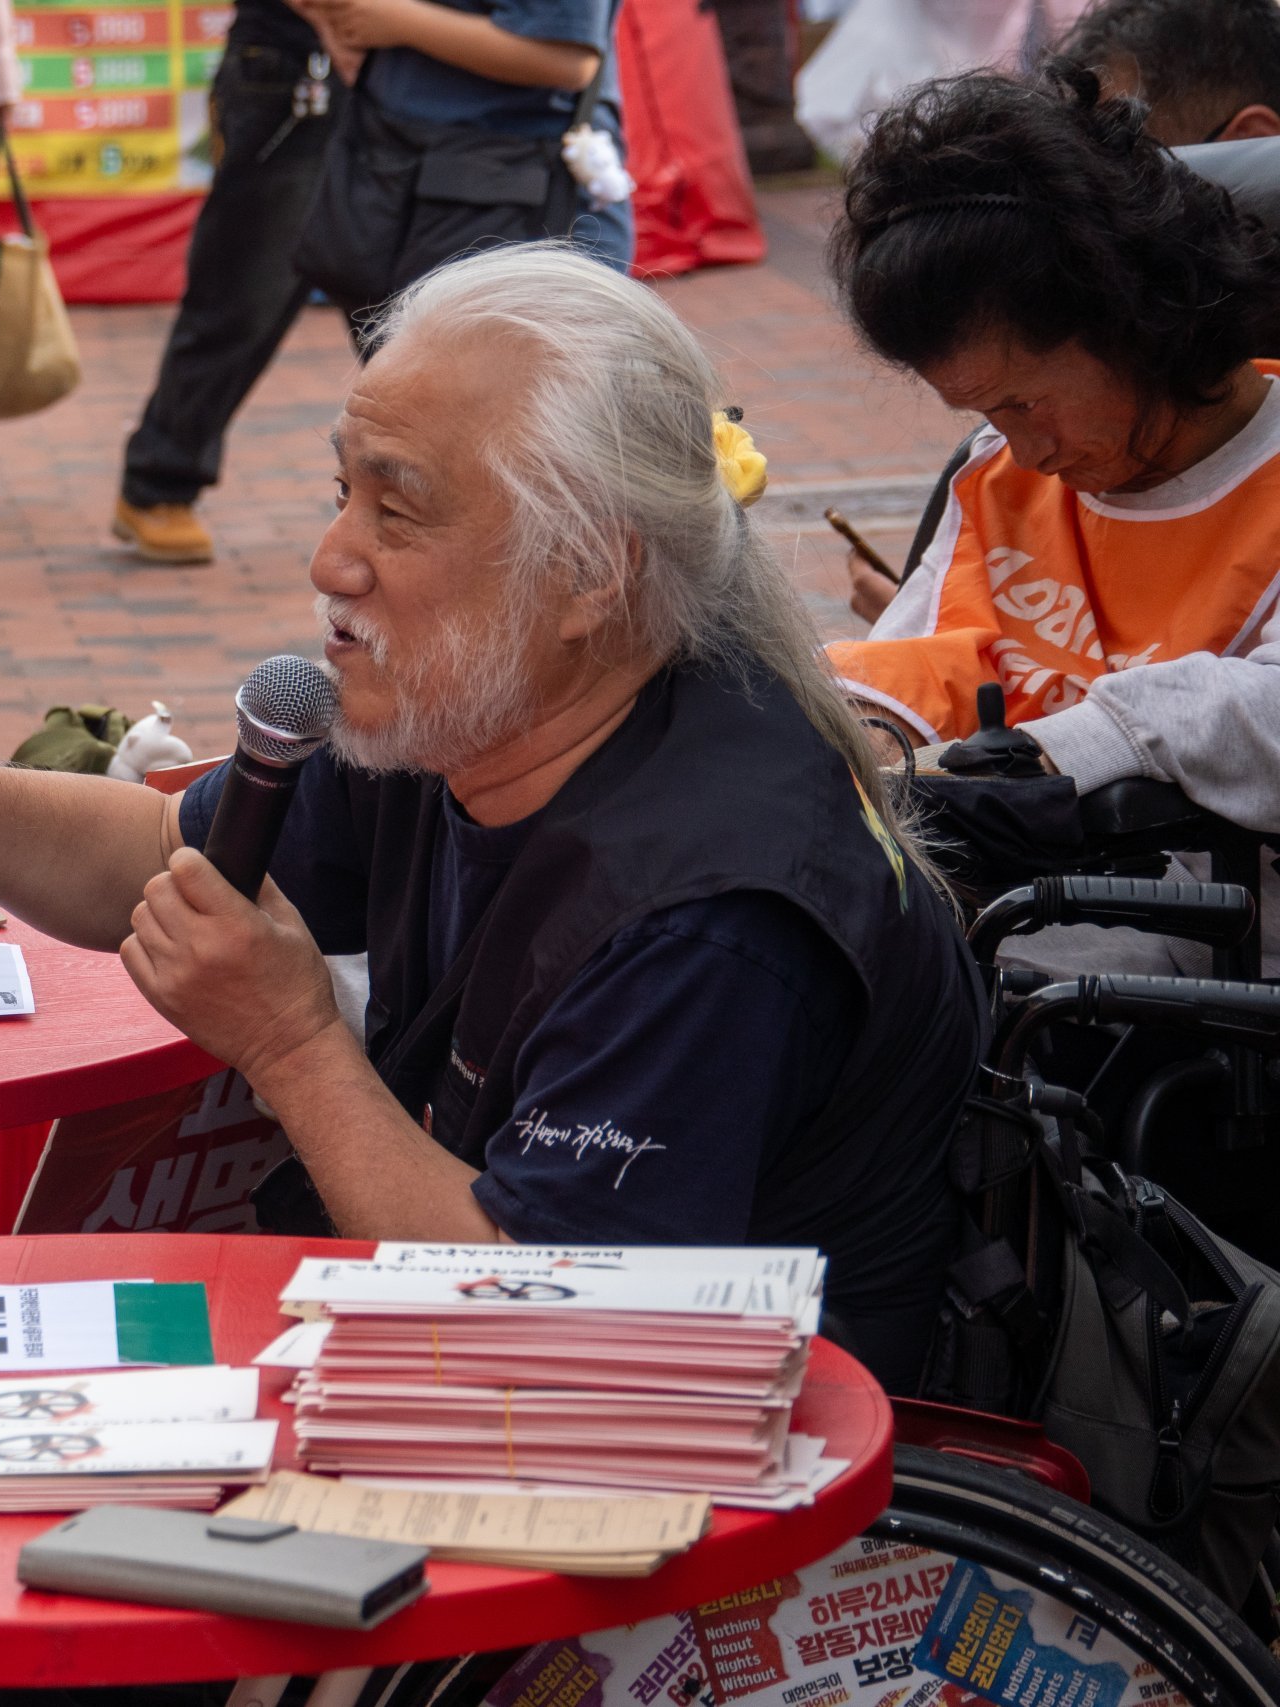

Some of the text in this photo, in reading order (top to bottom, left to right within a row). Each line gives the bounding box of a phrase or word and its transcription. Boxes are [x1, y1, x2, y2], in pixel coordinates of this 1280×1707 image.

[516, 1108, 667, 1190] 차별에 저항하라
[1049, 1505, 1243, 1647] SCHWALBE
[704, 1616, 762, 1642] Nothing
[710, 1635, 755, 1659] About
[945, 1591, 999, 1679] 예산없이
[969, 1603, 1024, 1691] 권리없다
[714, 1653, 763, 1677] Rights
[719, 1664, 778, 1693] Without
[1001, 1647, 1037, 1702] Nothing
[781, 1671, 843, 1705] 대한민국이
[1018, 1666, 1048, 1707] About
[1035, 1672, 1065, 1707] ights
